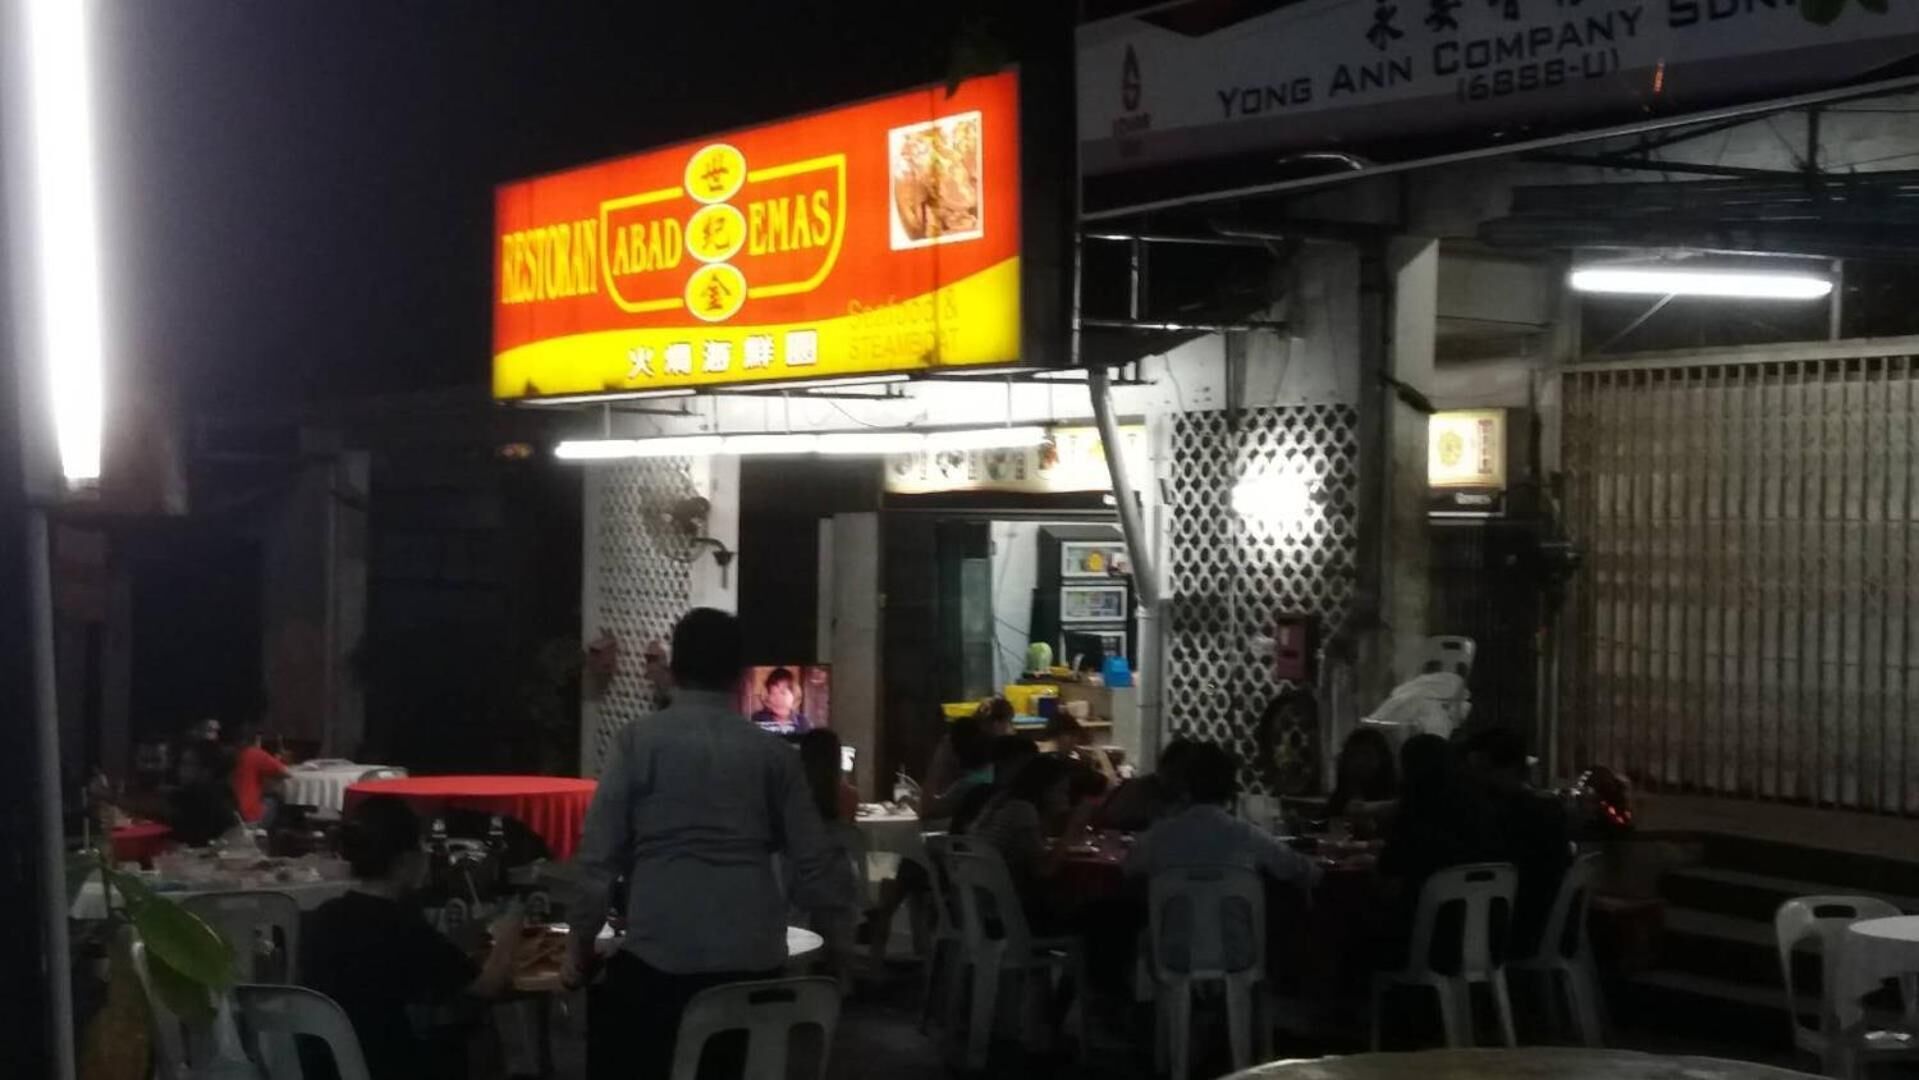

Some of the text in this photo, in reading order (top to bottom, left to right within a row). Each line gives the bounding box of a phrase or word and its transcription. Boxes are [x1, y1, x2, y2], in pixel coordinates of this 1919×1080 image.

[1216, 77, 1313, 118] YONG
[1328, 55, 1412, 97] ANN
[1432, 6, 1642, 77] COMPANY
[501, 189, 831, 304] RESTORAN ABAD EMAS
